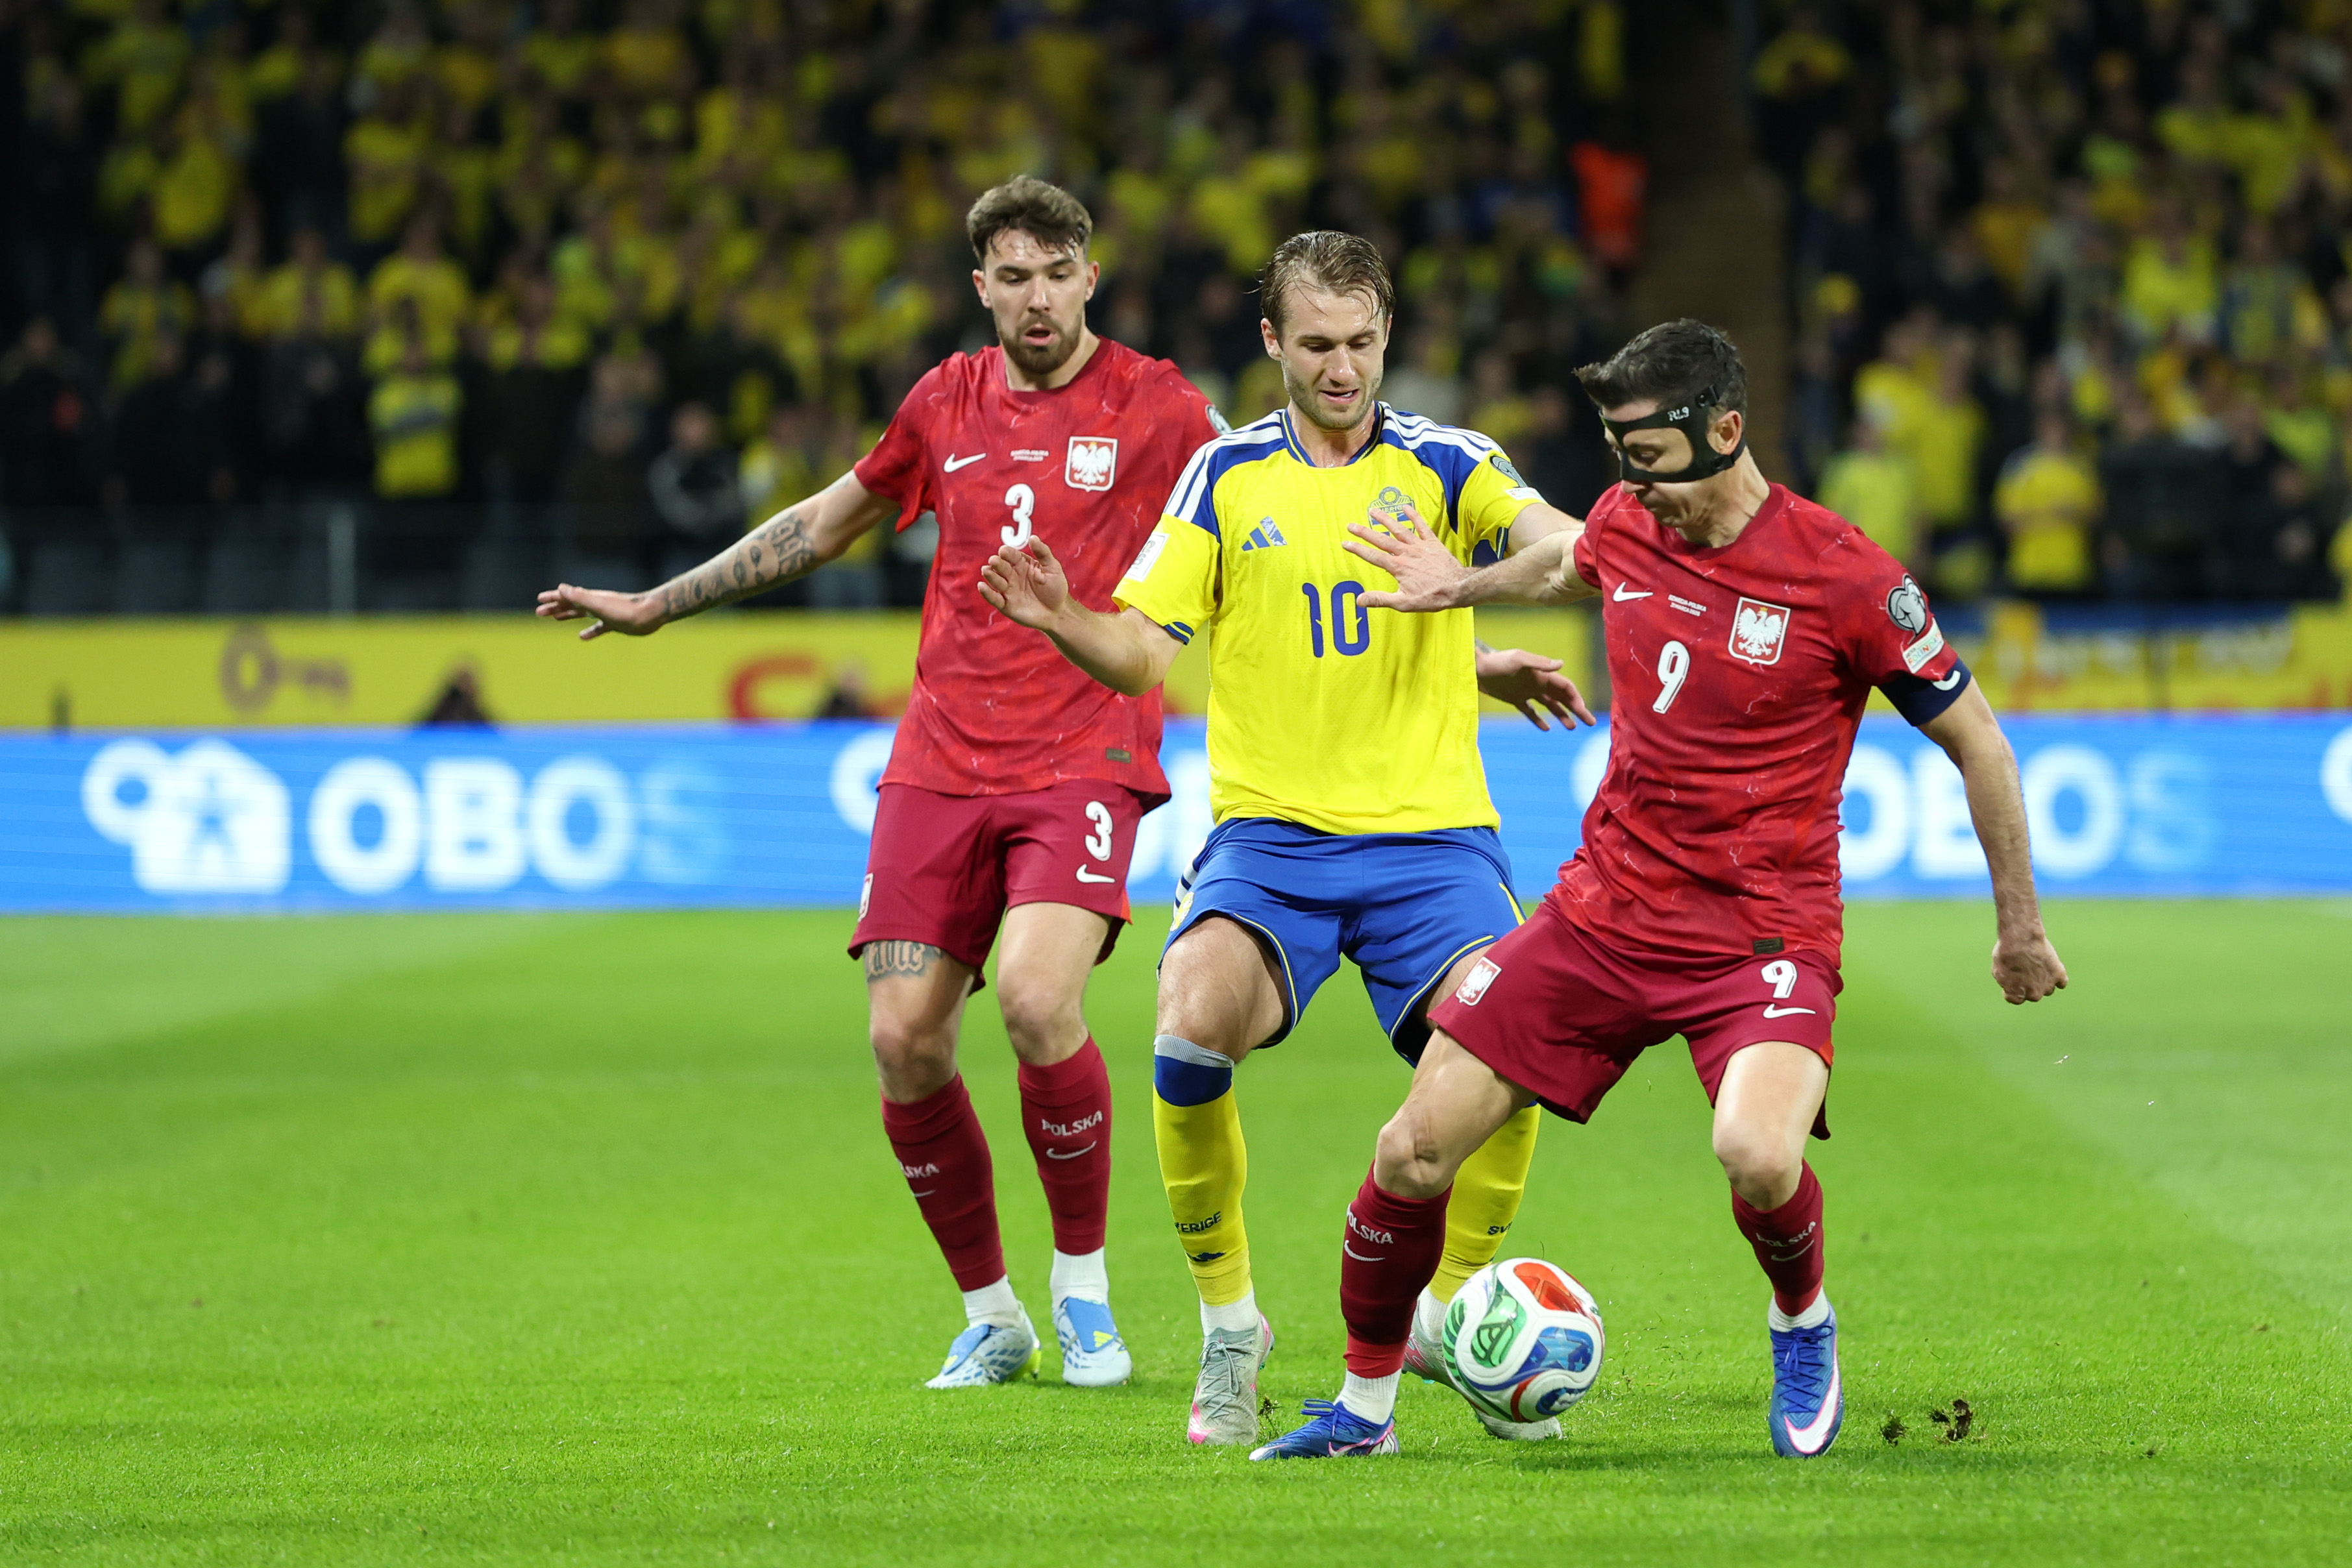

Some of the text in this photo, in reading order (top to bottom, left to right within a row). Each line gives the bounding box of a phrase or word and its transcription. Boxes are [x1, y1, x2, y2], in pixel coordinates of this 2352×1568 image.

[1667, 406, 1689, 421] RL9
[1001, 484, 1035, 550] 3
[1302, 580, 1370, 658] 10
[1652, 641, 1691, 715] 9
[308, 754, 729, 896] OBOS
[1084, 800, 1114, 862] 3
[1761, 959, 1798, 999] 9
[1041, 1110, 1103, 1136] POLSKA
